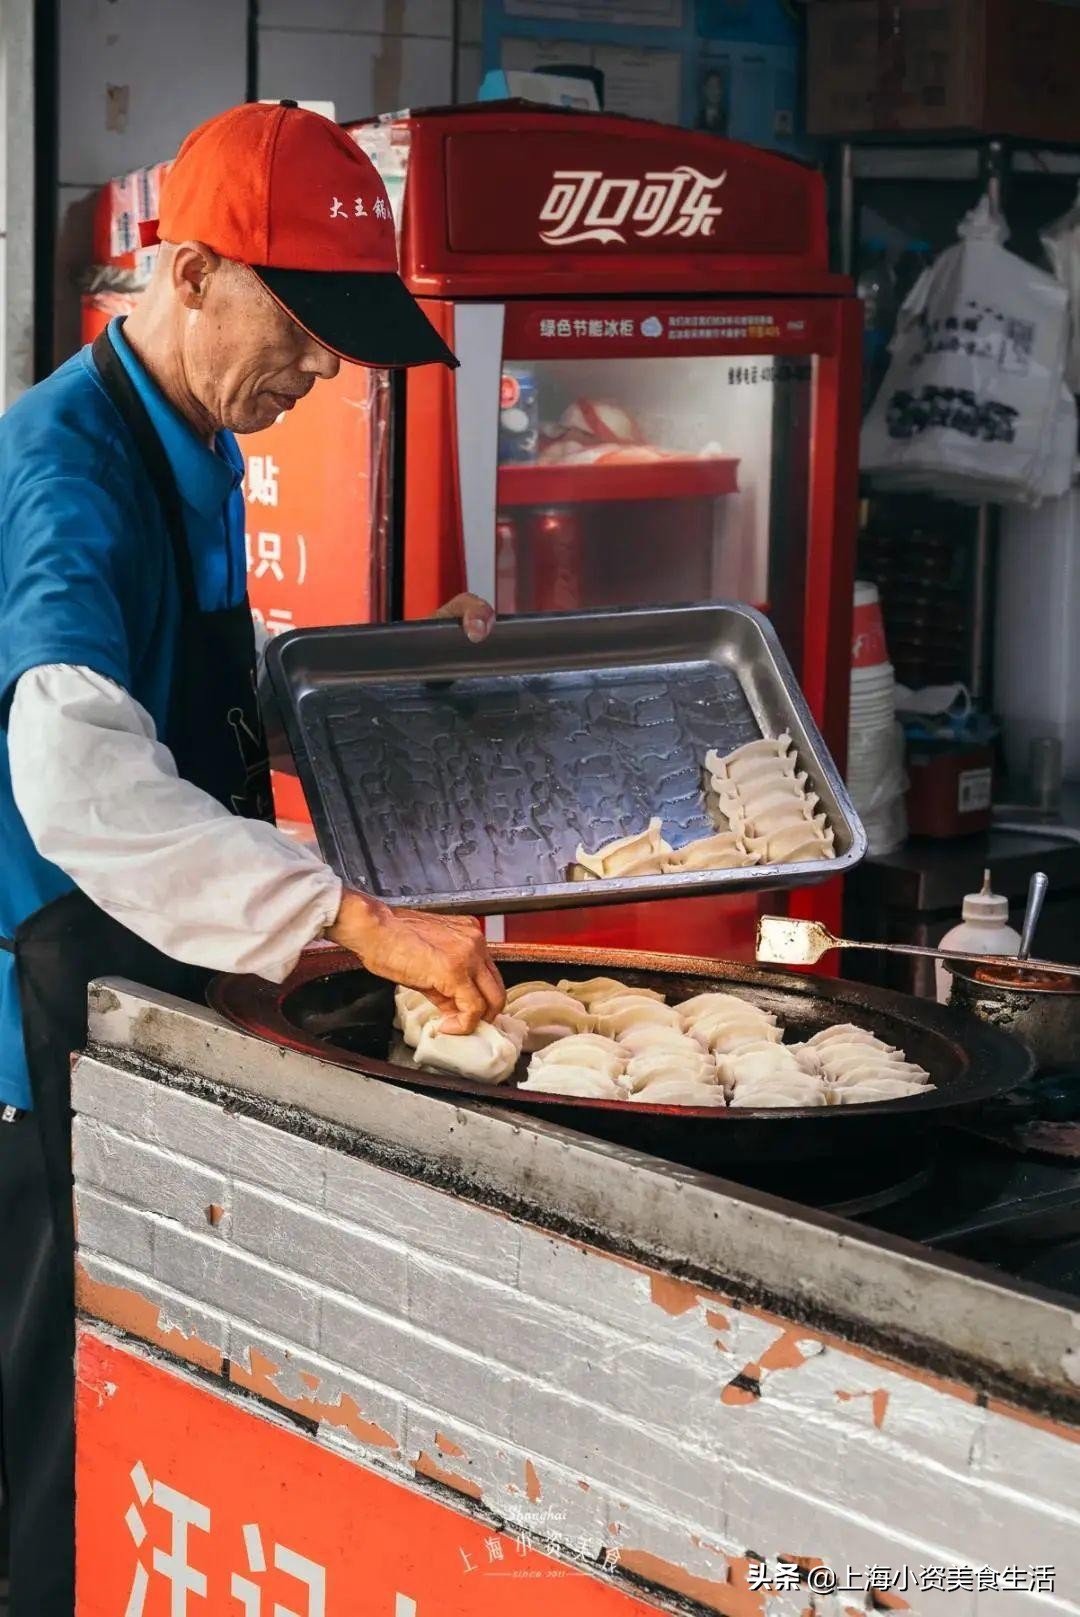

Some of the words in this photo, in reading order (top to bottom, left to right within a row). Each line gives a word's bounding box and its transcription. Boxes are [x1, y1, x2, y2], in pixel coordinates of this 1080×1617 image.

[329, 196, 392, 220] 大王锅
[539, 166, 727, 245] 可口可乐
[540, 319, 634, 338] 绿色节能冰柜
[241, 455, 280, 506] 贴
[124, 1459, 416, 1617] 汪记
